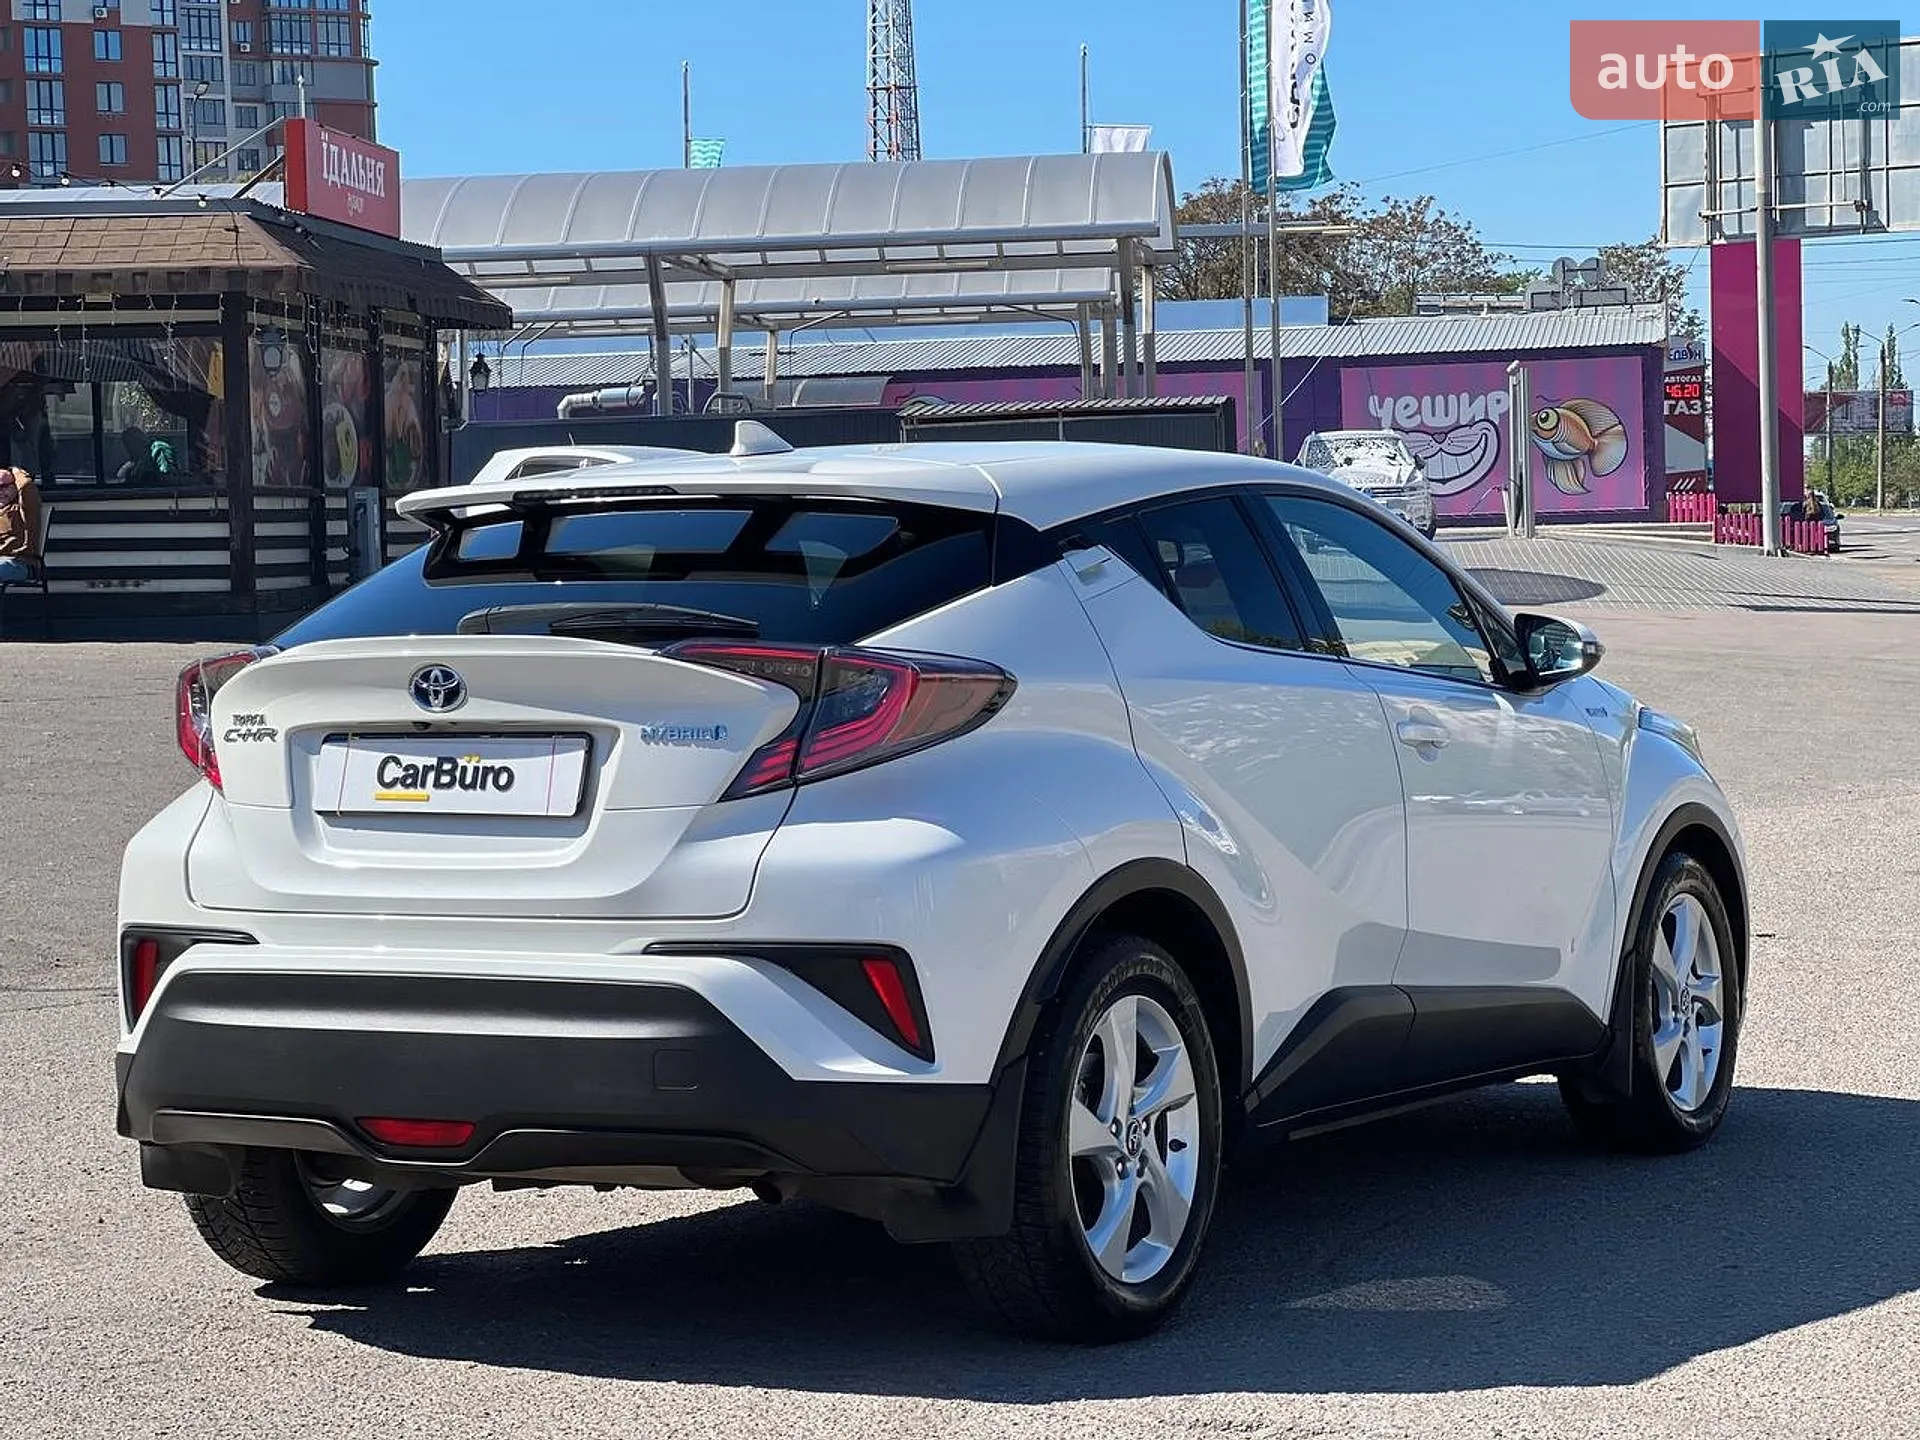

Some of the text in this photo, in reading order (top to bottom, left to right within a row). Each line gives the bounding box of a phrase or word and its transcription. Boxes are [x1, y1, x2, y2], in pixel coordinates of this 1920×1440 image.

[321, 131, 385, 198] ЇДАЛЬНЯ
[1664, 375, 1702, 384] АВТОГАЗ
[1664, 400, 1702, 415] ГАЗ
[377, 753, 515, 792] CarBüro
